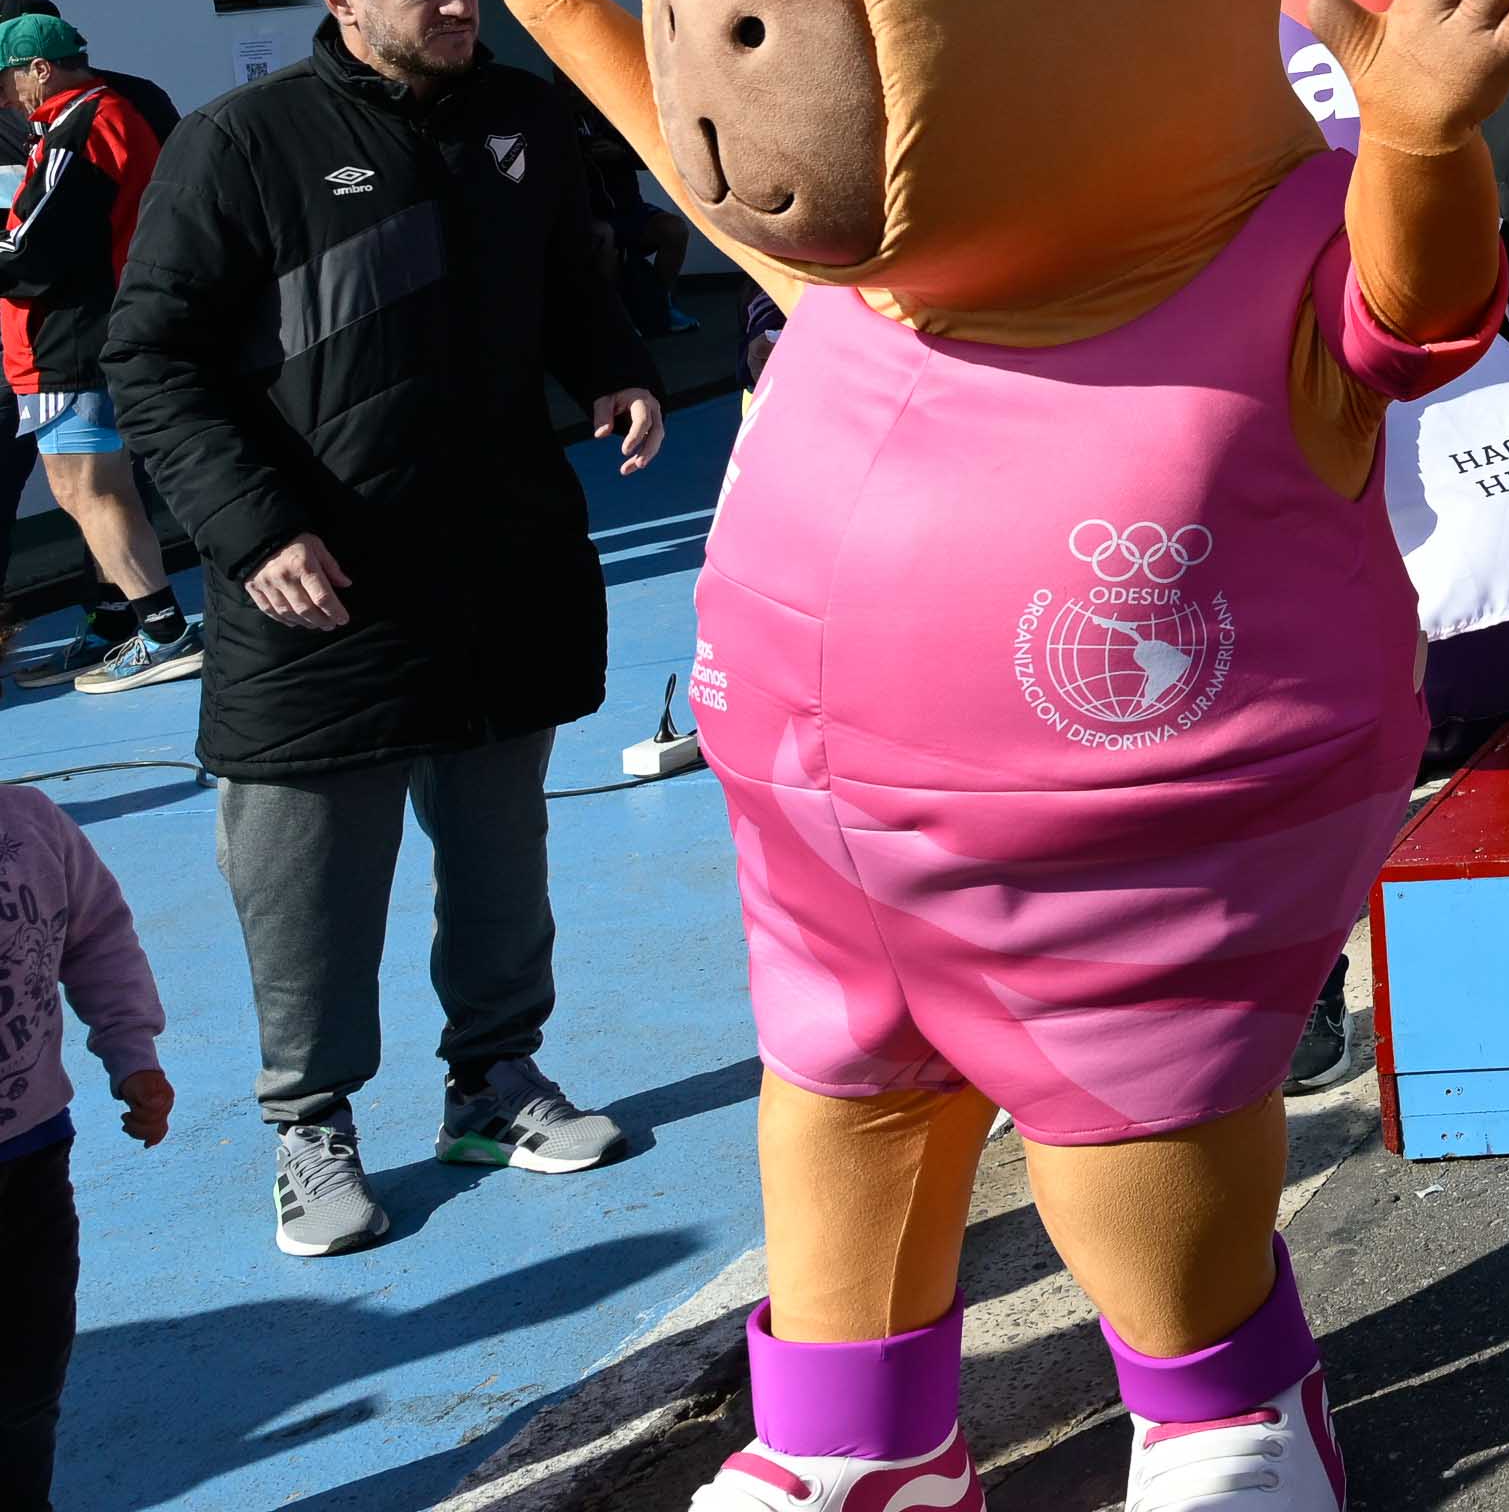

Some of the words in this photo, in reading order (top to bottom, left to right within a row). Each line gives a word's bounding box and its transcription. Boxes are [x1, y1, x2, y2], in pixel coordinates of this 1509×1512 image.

[332, 183, 374, 197] umbro
[1088, 585, 1182, 606] ODESUR
[1012, 588, 1070, 733] ORGANIZACION
[1066, 723, 1179, 752] DEPORTIVA
[1176, 590, 1236, 730] SURAMERICANA
